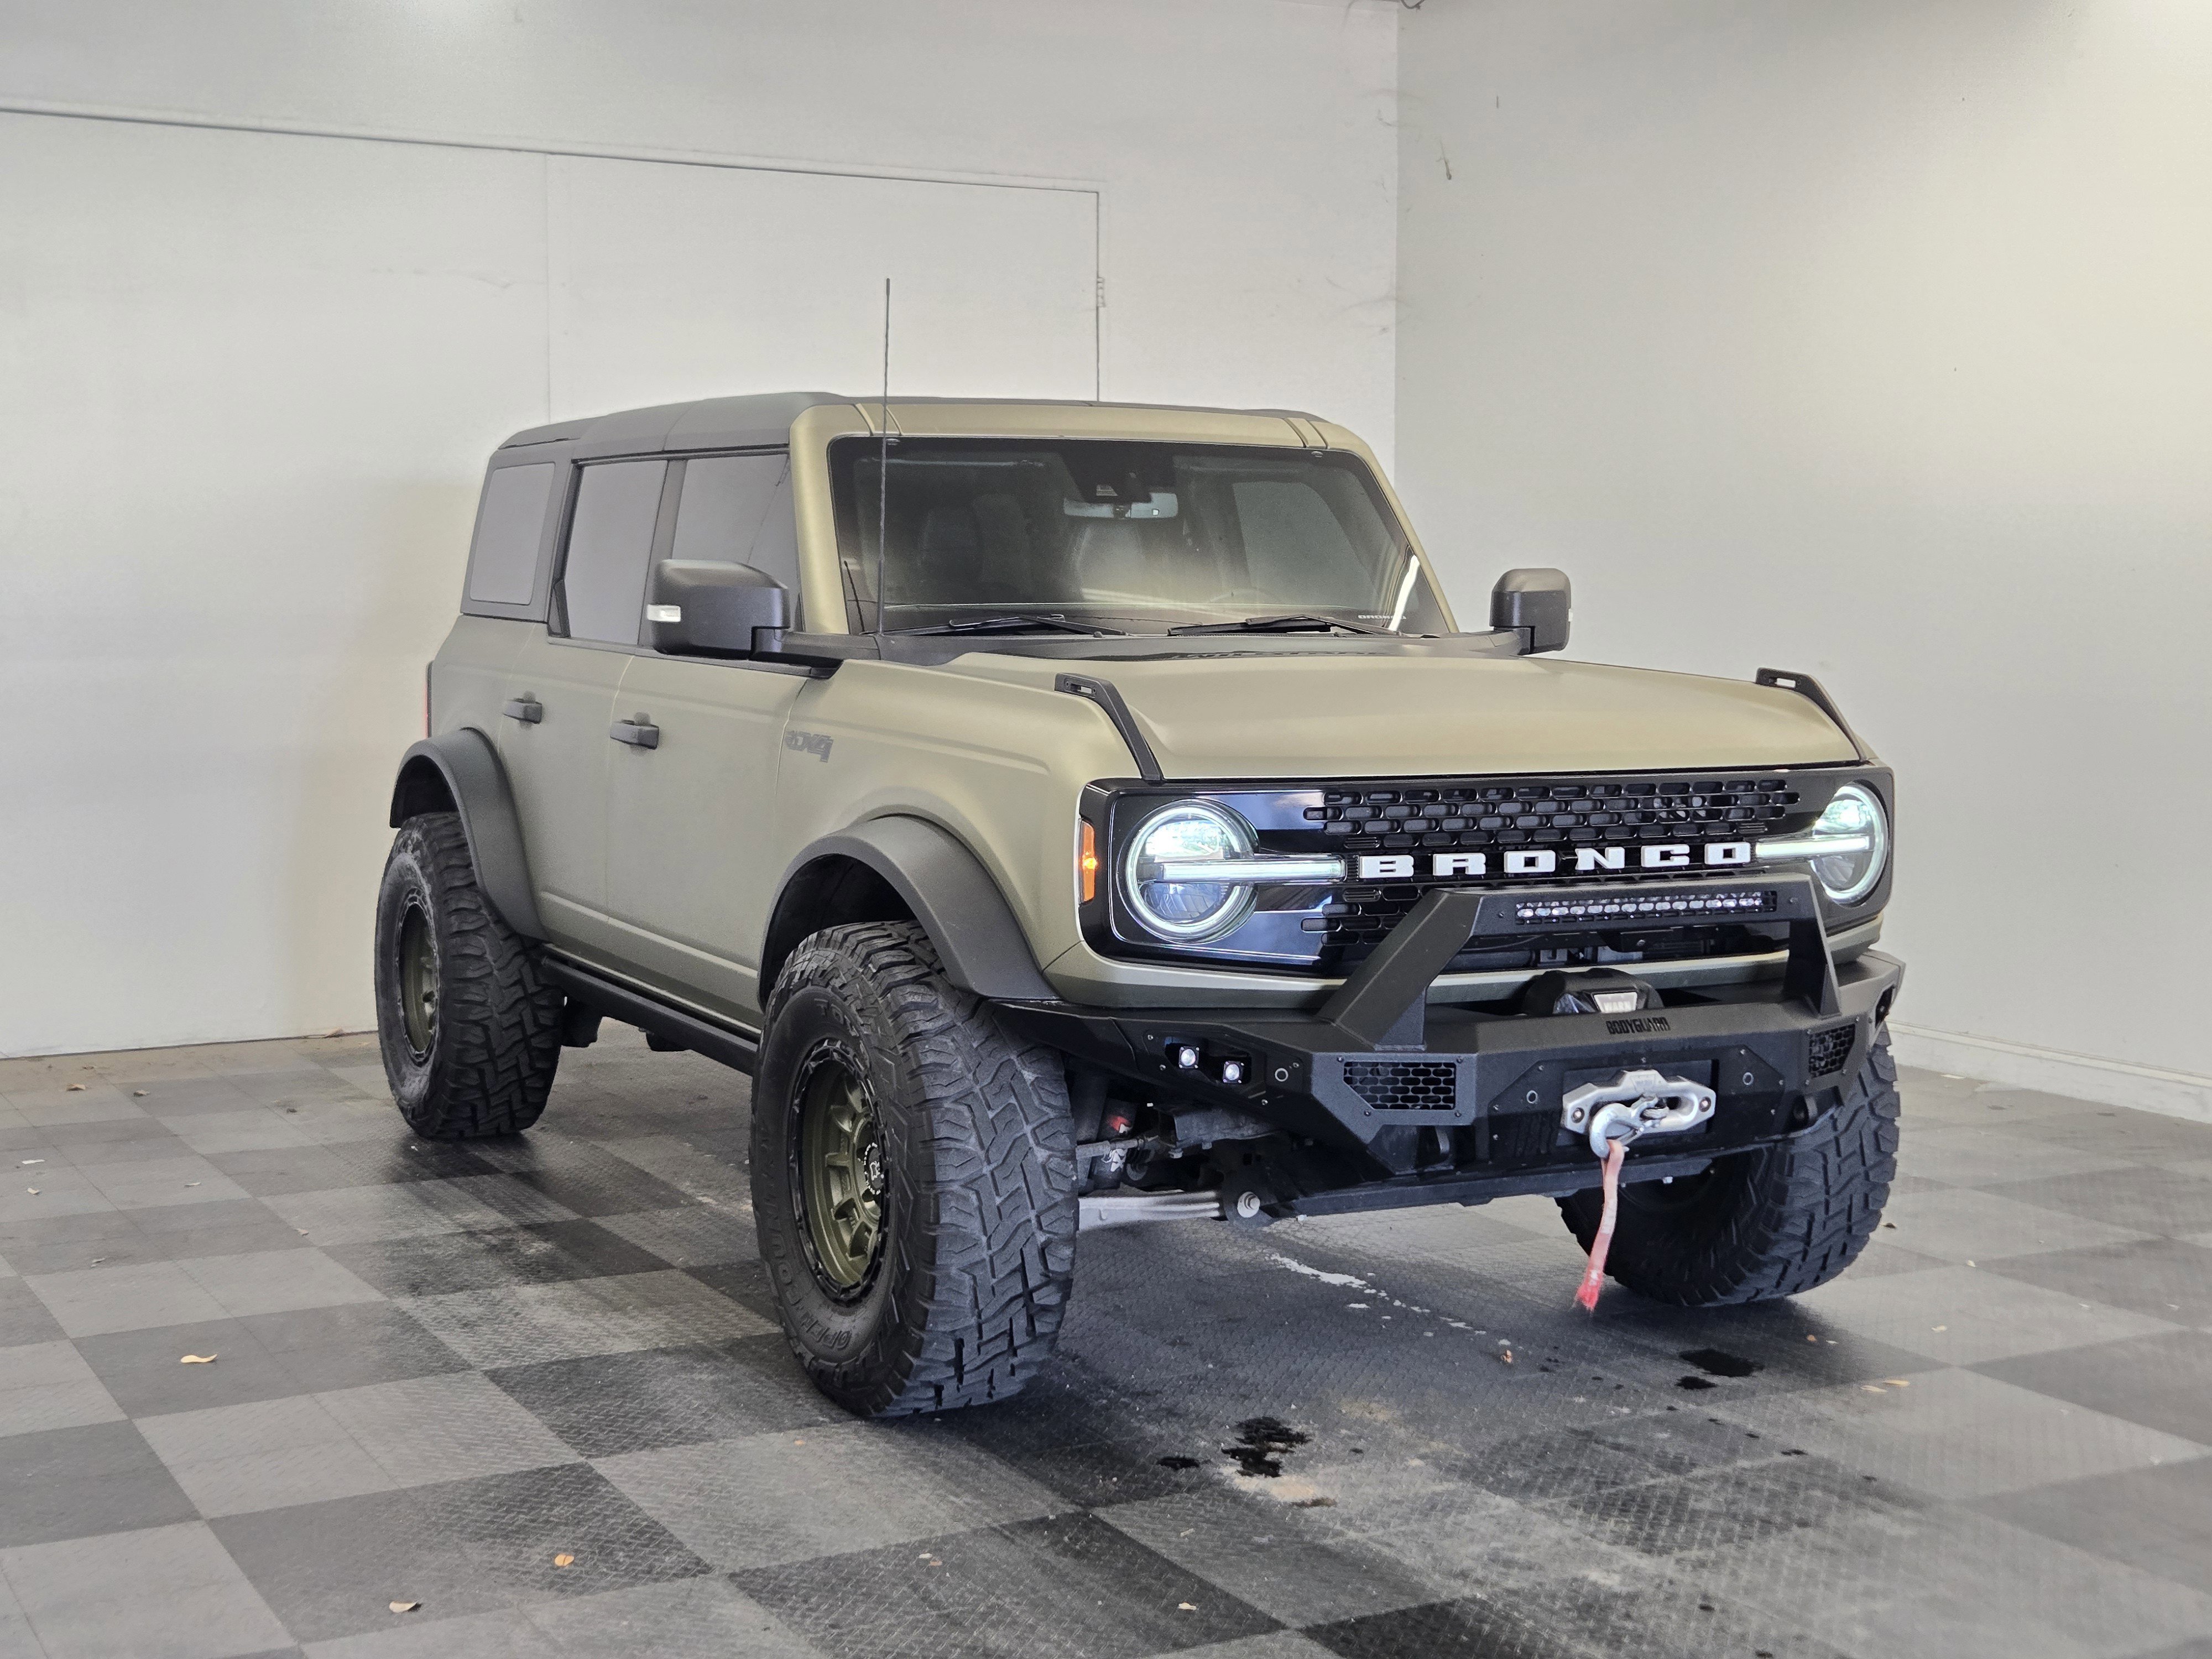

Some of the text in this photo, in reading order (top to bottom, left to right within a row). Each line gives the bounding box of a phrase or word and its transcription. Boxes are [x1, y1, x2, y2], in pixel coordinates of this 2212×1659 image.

[1359, 842, 1751, 879] BRONCO
[1603, 1001, 1632, 1013] WARN
[1605, 1016, 1671, 1035] BODYGUARD
